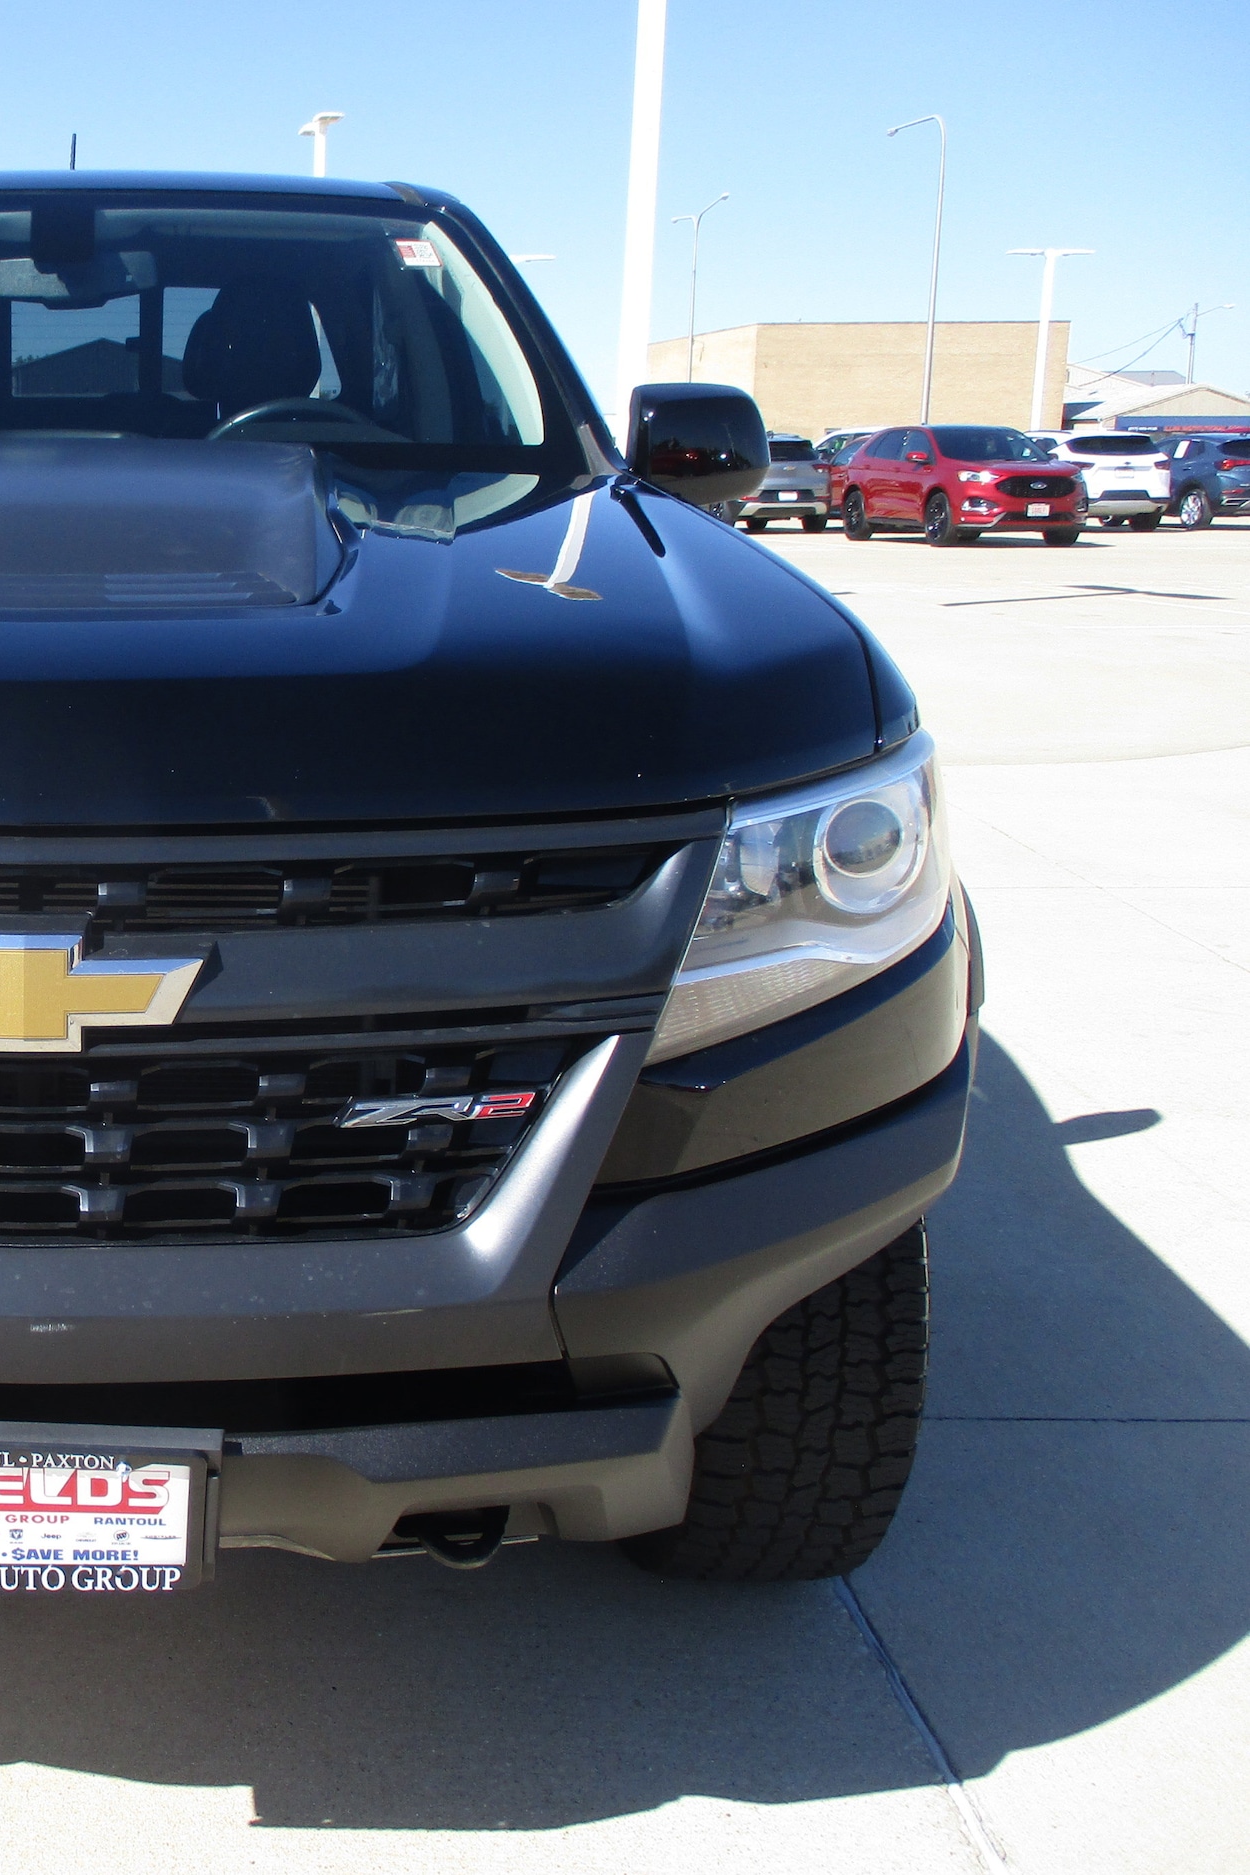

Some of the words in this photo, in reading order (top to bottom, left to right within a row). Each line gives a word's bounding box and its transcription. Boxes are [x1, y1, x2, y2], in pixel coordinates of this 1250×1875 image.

[340, 1091, 536, 1129] ZR2
[31, 1452, 114, 1470] PAXTON
[5, 1514, 70, 1524] GROUP
[94, 1517, 167, 1526] RANTOUL
[11, 1547, 64, 1561] $AVE
[72, 1549, 139, 1561] MORE!
[71, 1564, 181, 1592] GROUP
